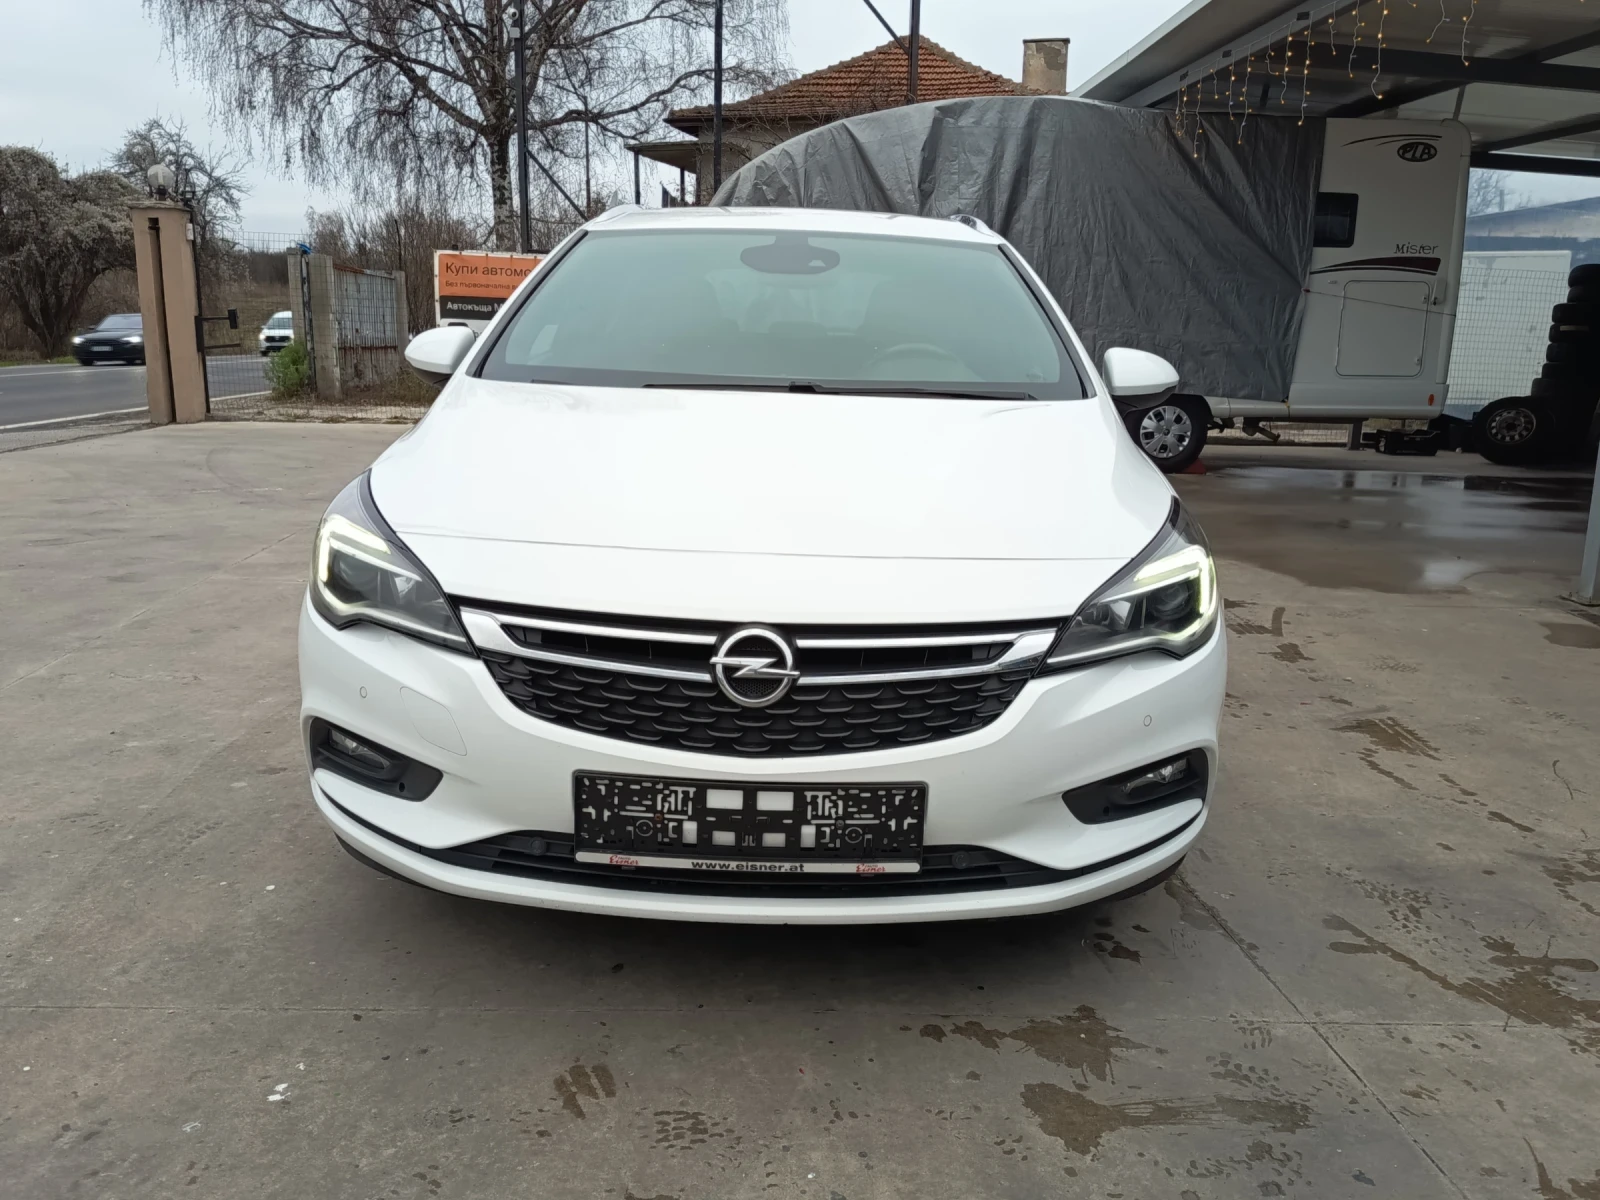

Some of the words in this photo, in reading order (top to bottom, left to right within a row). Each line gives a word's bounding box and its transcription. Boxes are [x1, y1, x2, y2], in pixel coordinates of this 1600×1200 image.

[1393, 241, 1439, 255] Mister
[445, 262, 478, 276] Купи
[459, 281, 511, 290] първоначална
[446, 301, 492, 312] Автокъща
[691, 861, 805, 872] www.eisner.at
